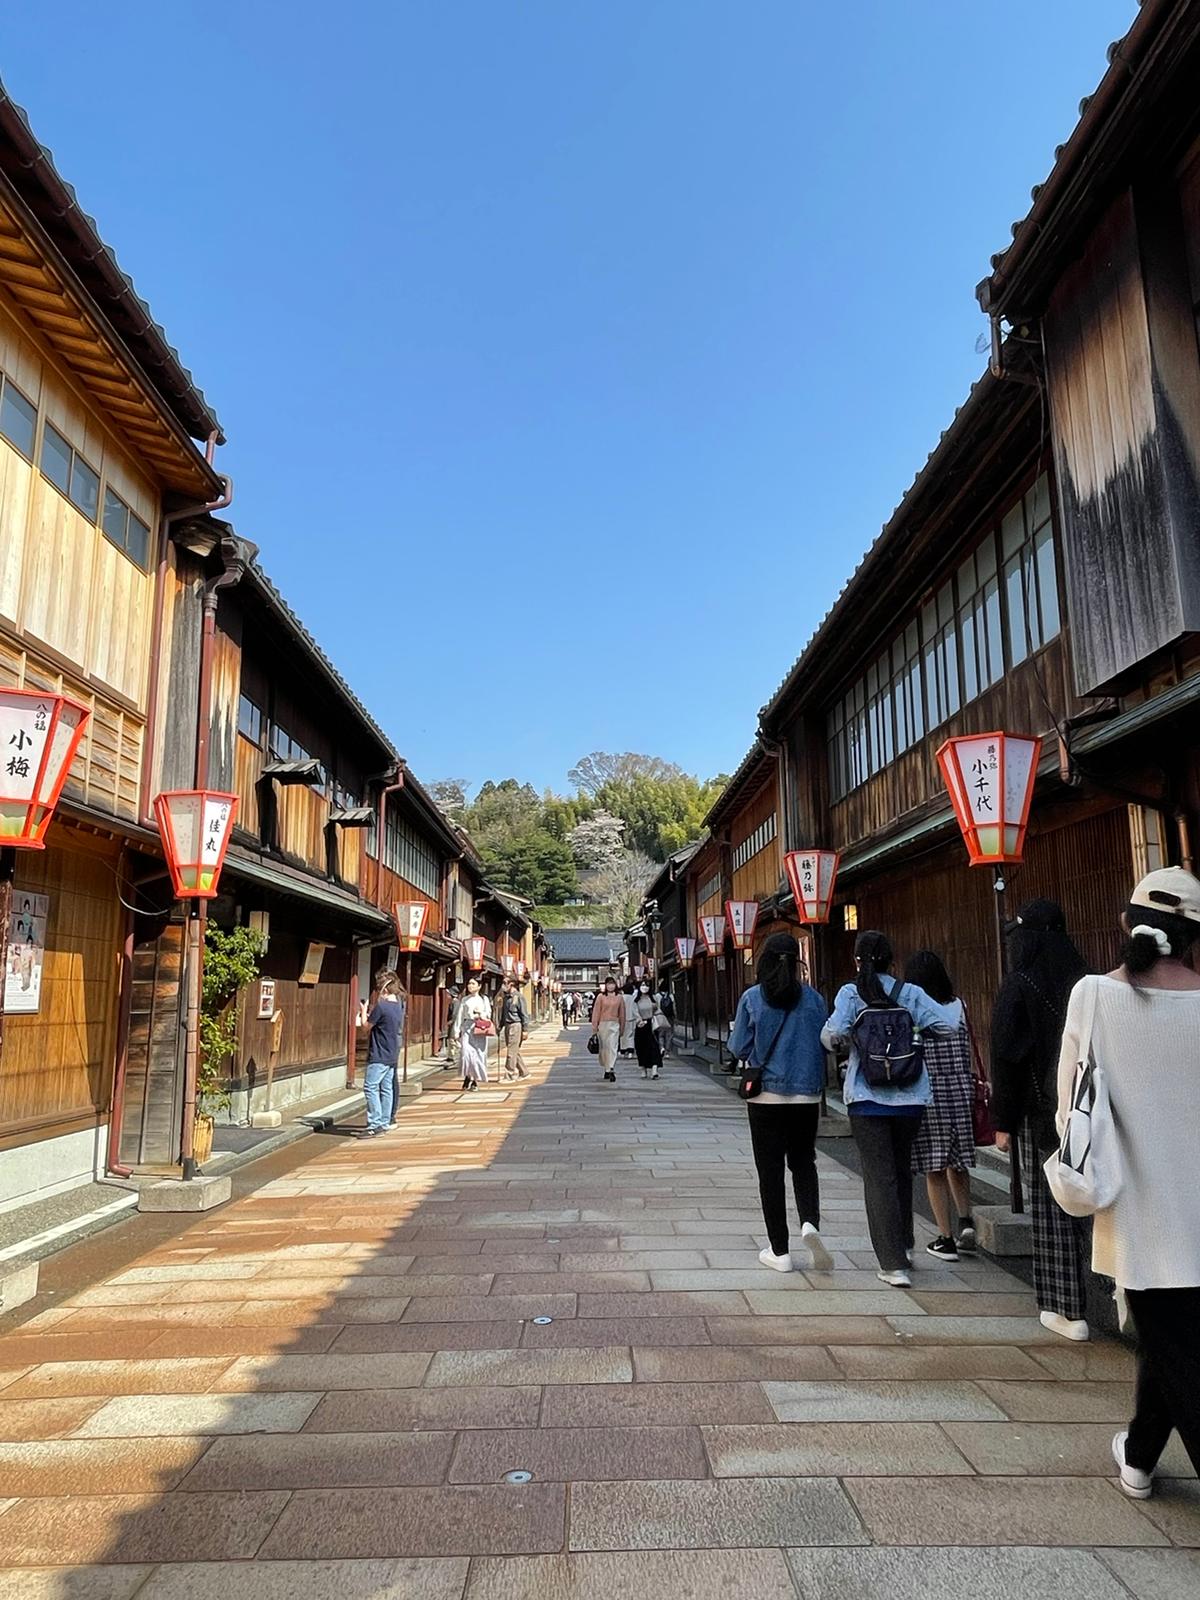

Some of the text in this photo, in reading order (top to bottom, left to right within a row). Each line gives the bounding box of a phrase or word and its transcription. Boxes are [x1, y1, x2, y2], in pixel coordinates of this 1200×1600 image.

[34, 703, 48, 731] 八の福
[5, 729, 33, 779] 小梅
[972, 759, 993, 812] 小千代
